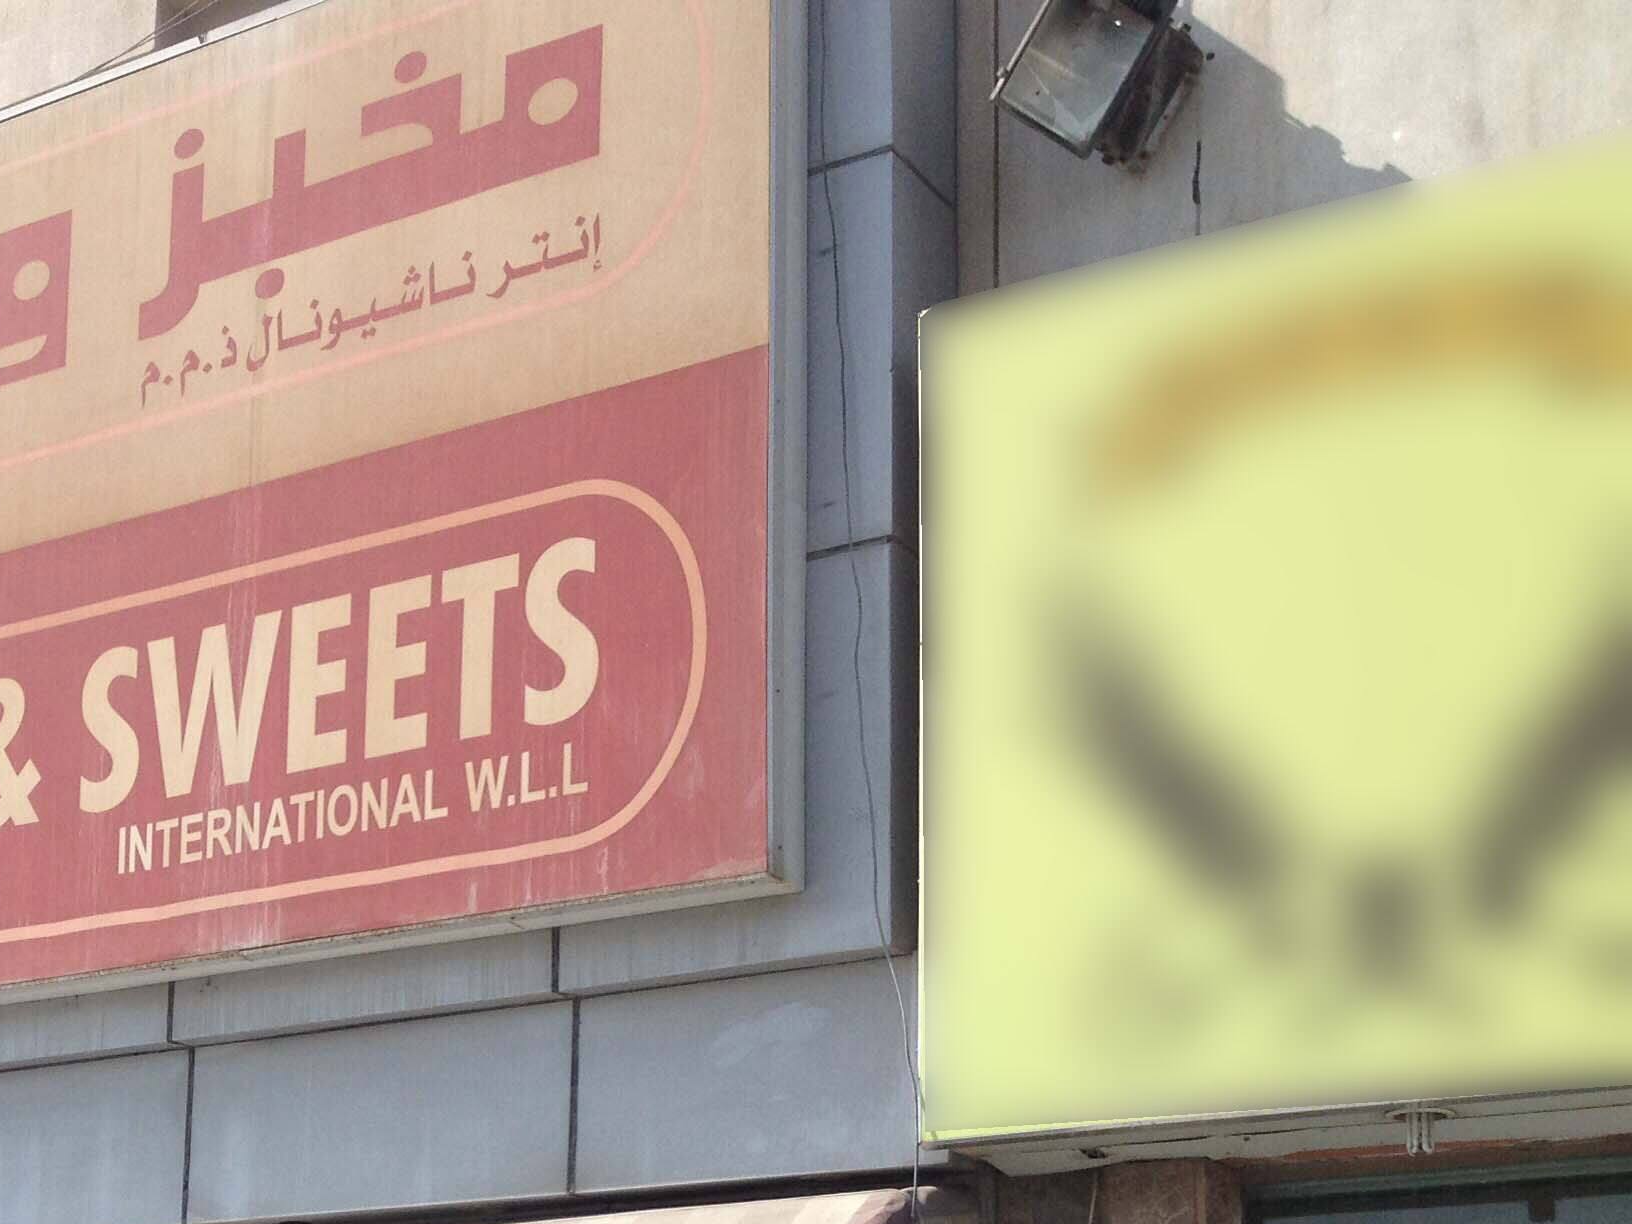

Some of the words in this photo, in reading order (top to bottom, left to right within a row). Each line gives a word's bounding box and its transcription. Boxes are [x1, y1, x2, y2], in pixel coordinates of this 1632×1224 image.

[139, 25, 603, 340] مخبز
[79, 537, 599, 814] SWEETS
[117, 769, 449, 875] INTERNATIONAL
[465, 743, 589, 813] W.L.L
